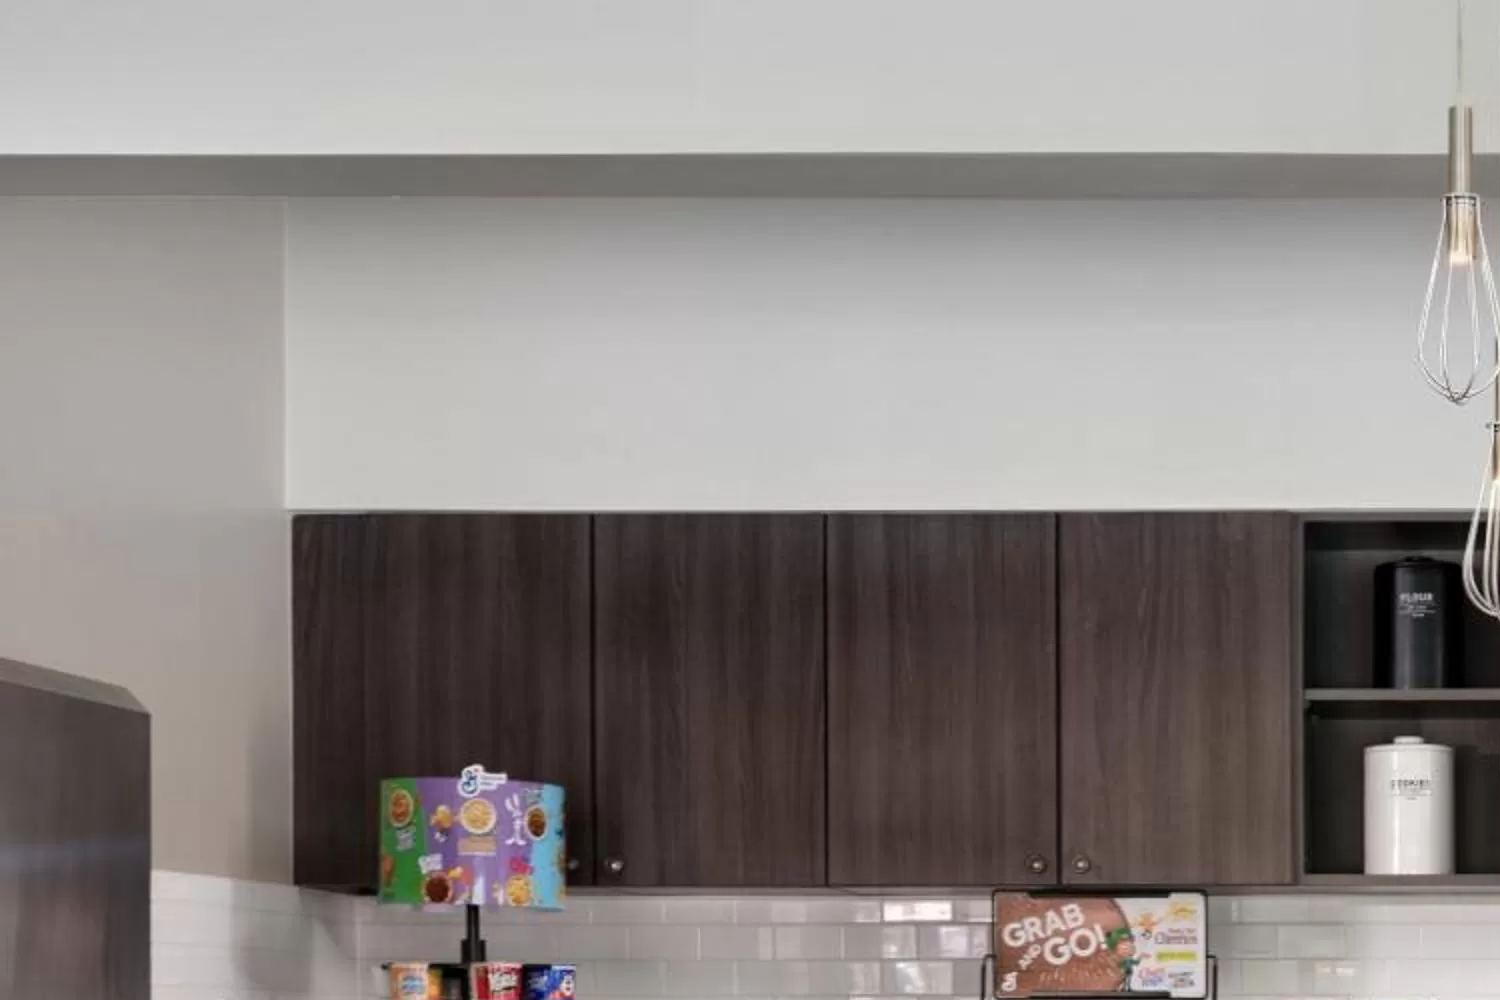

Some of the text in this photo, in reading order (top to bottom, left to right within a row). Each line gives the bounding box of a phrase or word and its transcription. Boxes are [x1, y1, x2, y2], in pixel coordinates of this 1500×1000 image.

[1002, 903, 1086, 947] GRAB
[1043, 923, 1108, 966] GO!
[1018, 943, 1041, 970] AND
